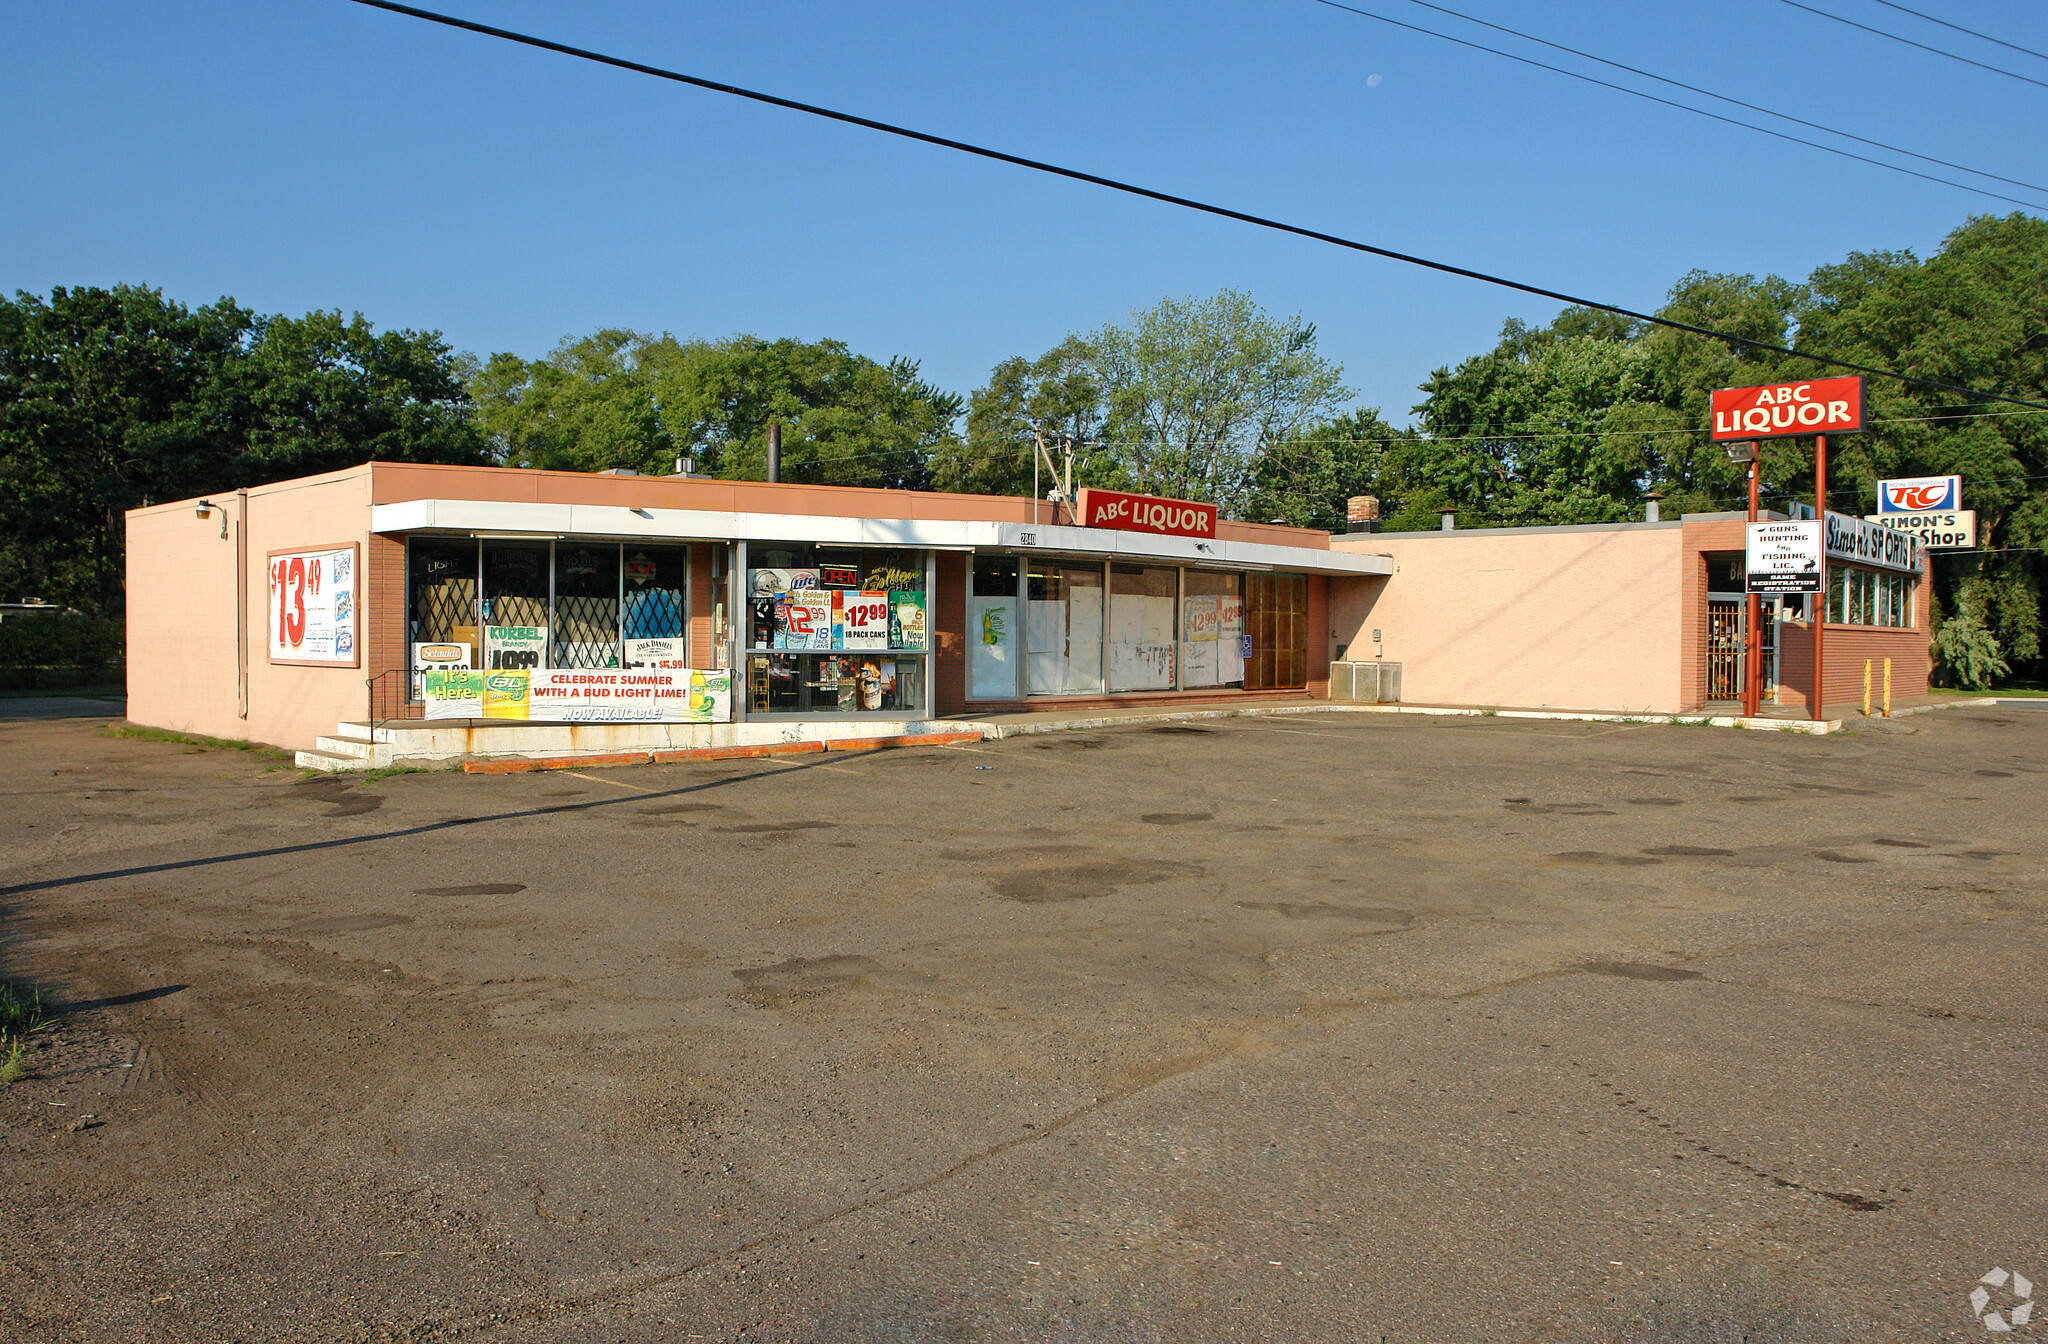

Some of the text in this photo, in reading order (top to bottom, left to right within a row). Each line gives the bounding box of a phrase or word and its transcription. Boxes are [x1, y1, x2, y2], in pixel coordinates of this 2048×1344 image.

[1756, 385, 1810, 406] ABC
[1716, 400, 1852, 432] LIQUOR
[1889, 485, 1946, 509] RC
[1095, 499, 1209, 532] ABC LIQUOR
[1880, 515, 1955, 529] SIMON'S
[1020, 533, 1036, 545] 2840
[1827, 514, 1868, 557] Simon's
[1871, 528, 1908, 566] SPORTS
[1919, 529, 1966, 546] Shop
[824, 569, 857, 584] OPEN
[915, 609, 923, 620] 6
[490, 627, 543, 640] KORBEL
[815, 628, 829, 639] 18
[907, 631, 924, 639] Now
[636, 641, 650, 652] JACK
[890, 638, 924, 648] Available
[423, 647, 459, 658] Schmidt
[443, 670, 468, 684] It's
[491, 677, 520, 688] BL
[551, 675, 672, 685] CELEBRATE SUMMER
[435, 685, 477, 701] Here.
[534, 687, 686, 698] WITH A BUD LIGHT LIME!
[562, 708, 664, 721] NOW AVAILABLE!
